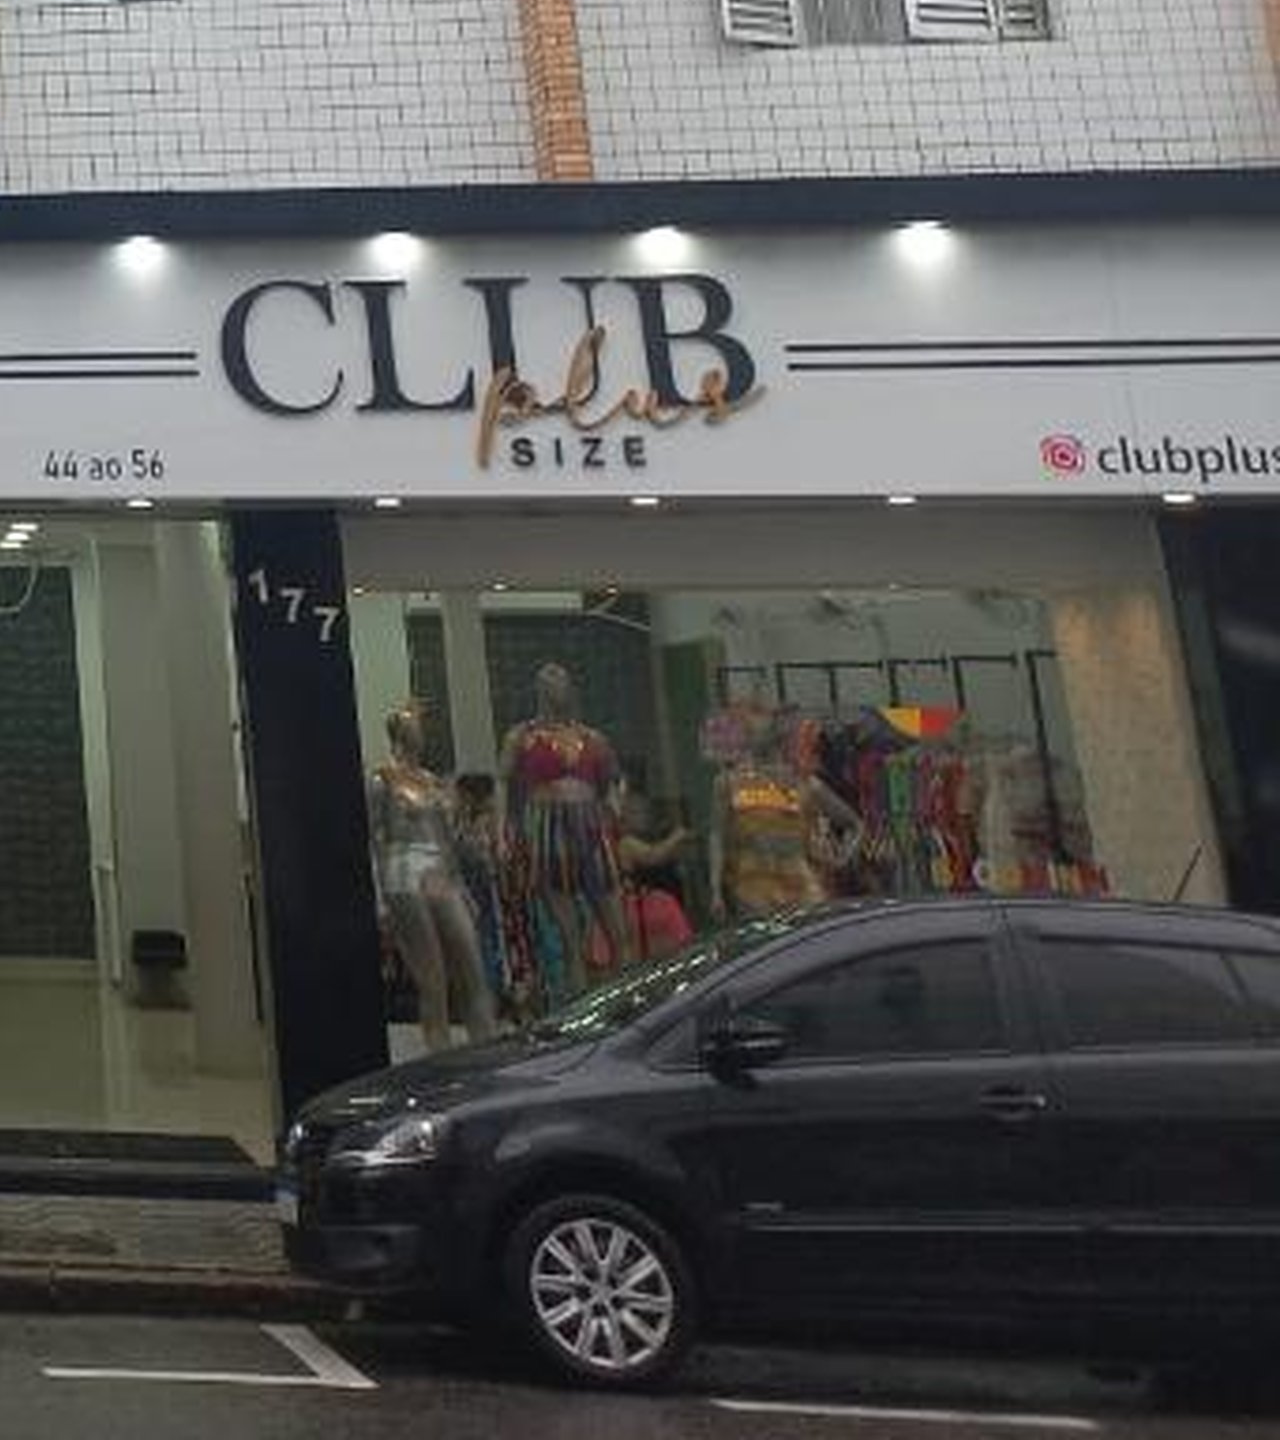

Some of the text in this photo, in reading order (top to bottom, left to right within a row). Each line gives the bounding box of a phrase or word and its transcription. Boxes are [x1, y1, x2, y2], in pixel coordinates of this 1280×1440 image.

[221, 273, 757, 417] CLUB
[477, 325, 766, 470] plus
[45, 449, 165, 480] 44 ao 56
[510, 437, 648, 467] SIZE
[248, 569, 340, 642] 177
